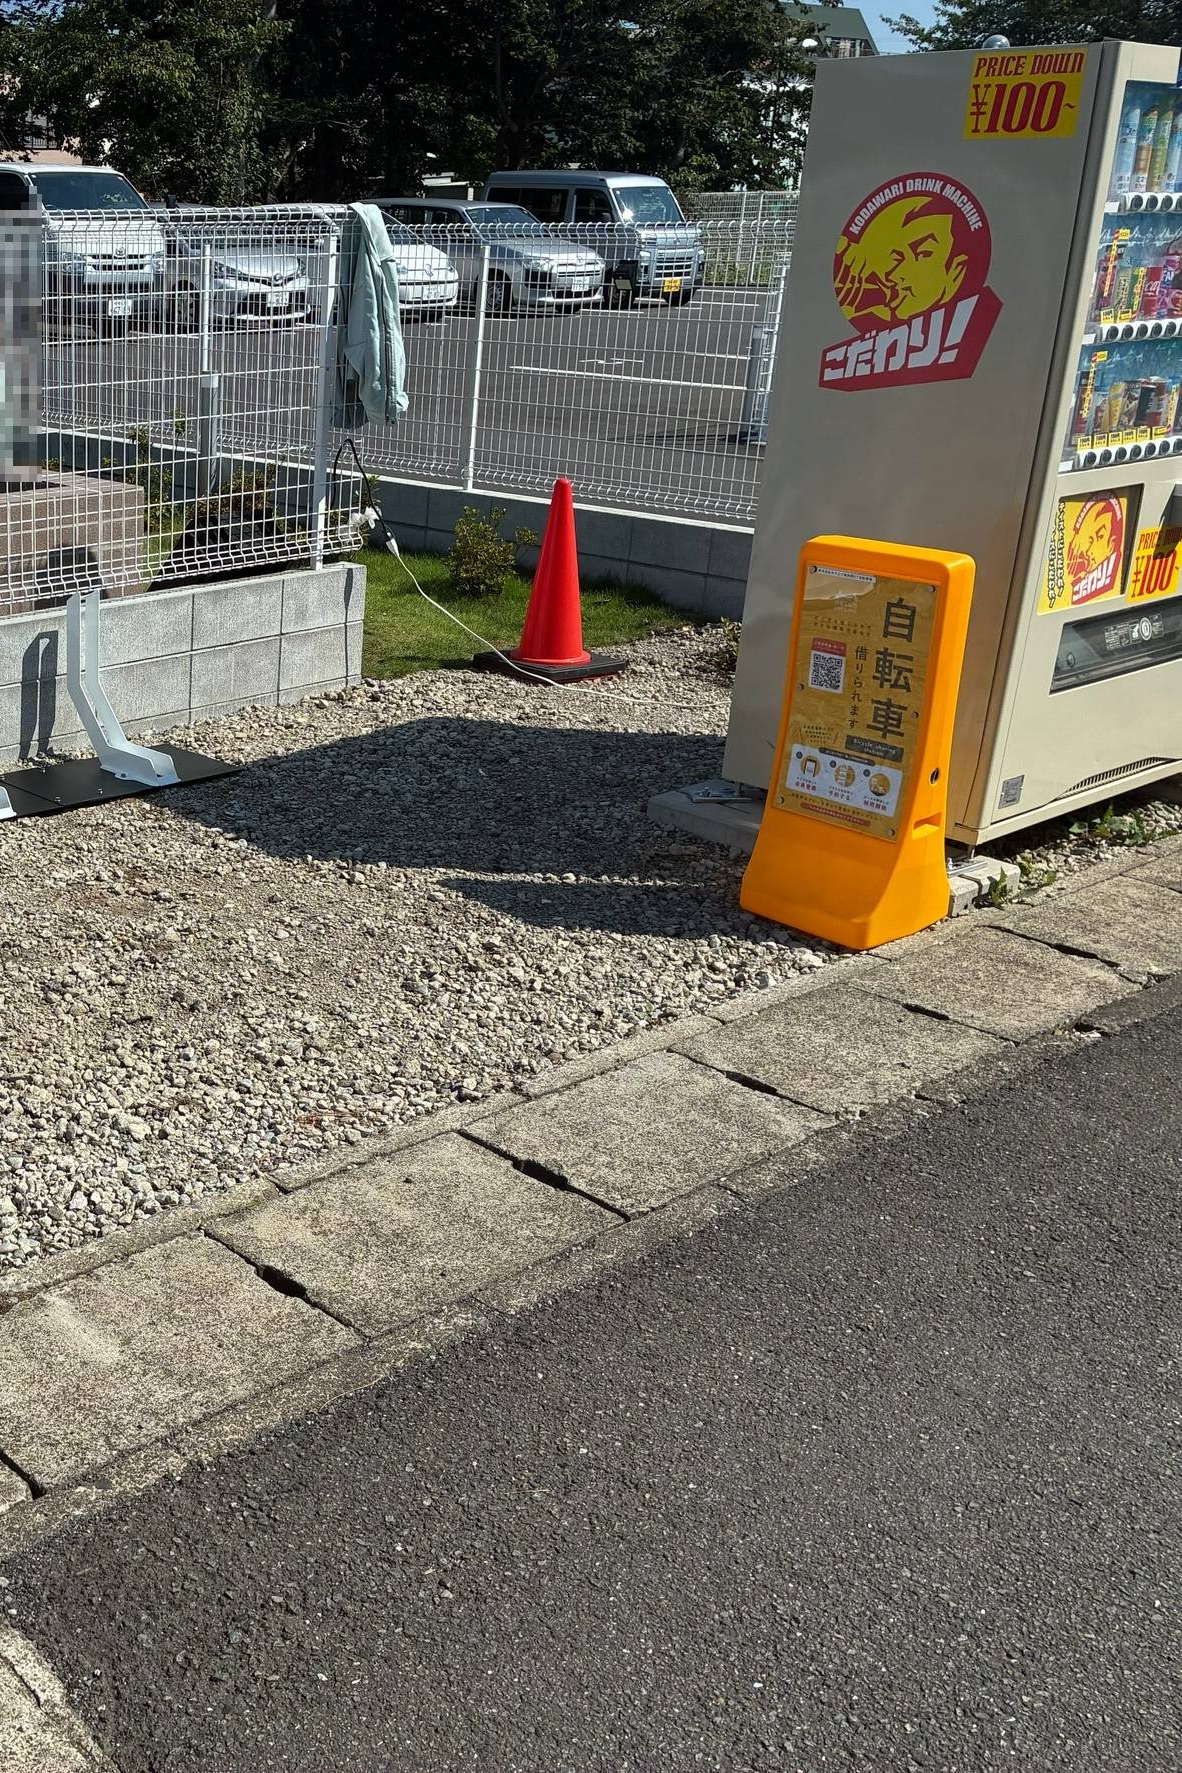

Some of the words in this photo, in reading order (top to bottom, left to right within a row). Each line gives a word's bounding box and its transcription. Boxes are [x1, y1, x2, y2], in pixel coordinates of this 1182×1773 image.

[974, 56, 1026, 77] PRICE
[1030, 52, 1085, 75] DOWN
[849, 181, 904, 235] KODAWARI
[906, 178, 943, 194] DRINK
[942, 183, 983, 232] MACHINE
[823, 294, 979, 381] こだわり!
[848, 645, 869, 729] 借りられます
[866, 597, 917, 739] 自転車
